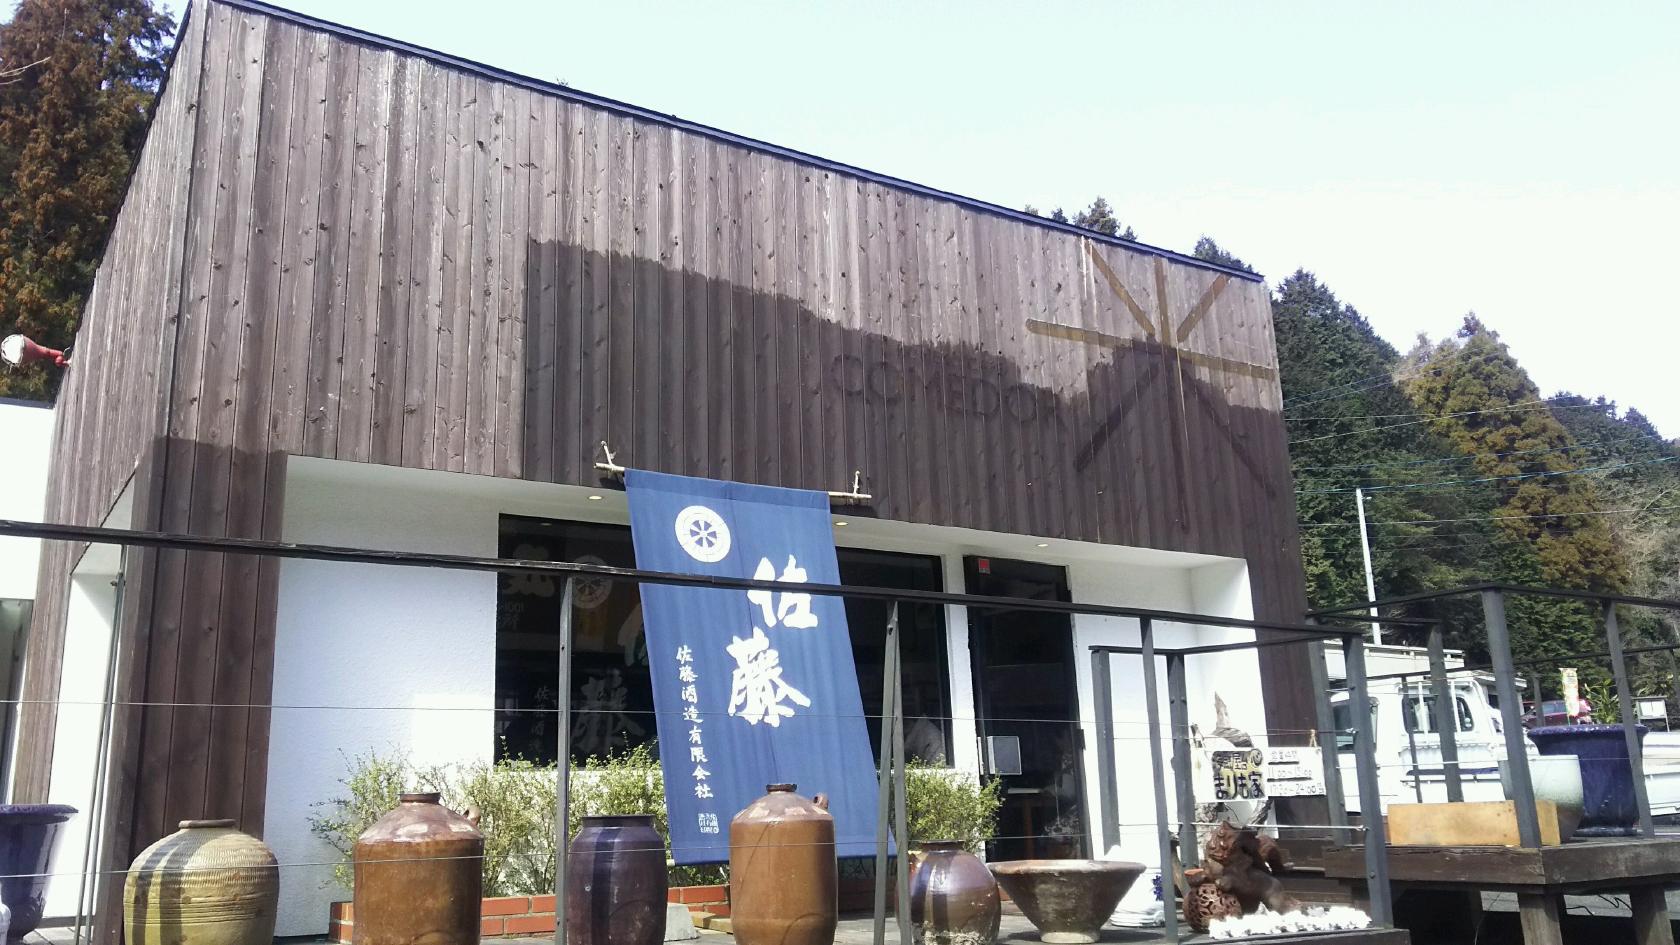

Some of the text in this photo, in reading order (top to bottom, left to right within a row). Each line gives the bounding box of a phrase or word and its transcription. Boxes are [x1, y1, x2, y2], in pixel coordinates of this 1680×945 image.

[676, 645, 714, 800] 佐藤酒造有限会社
[726, 555, 818, 727] 佐藤
